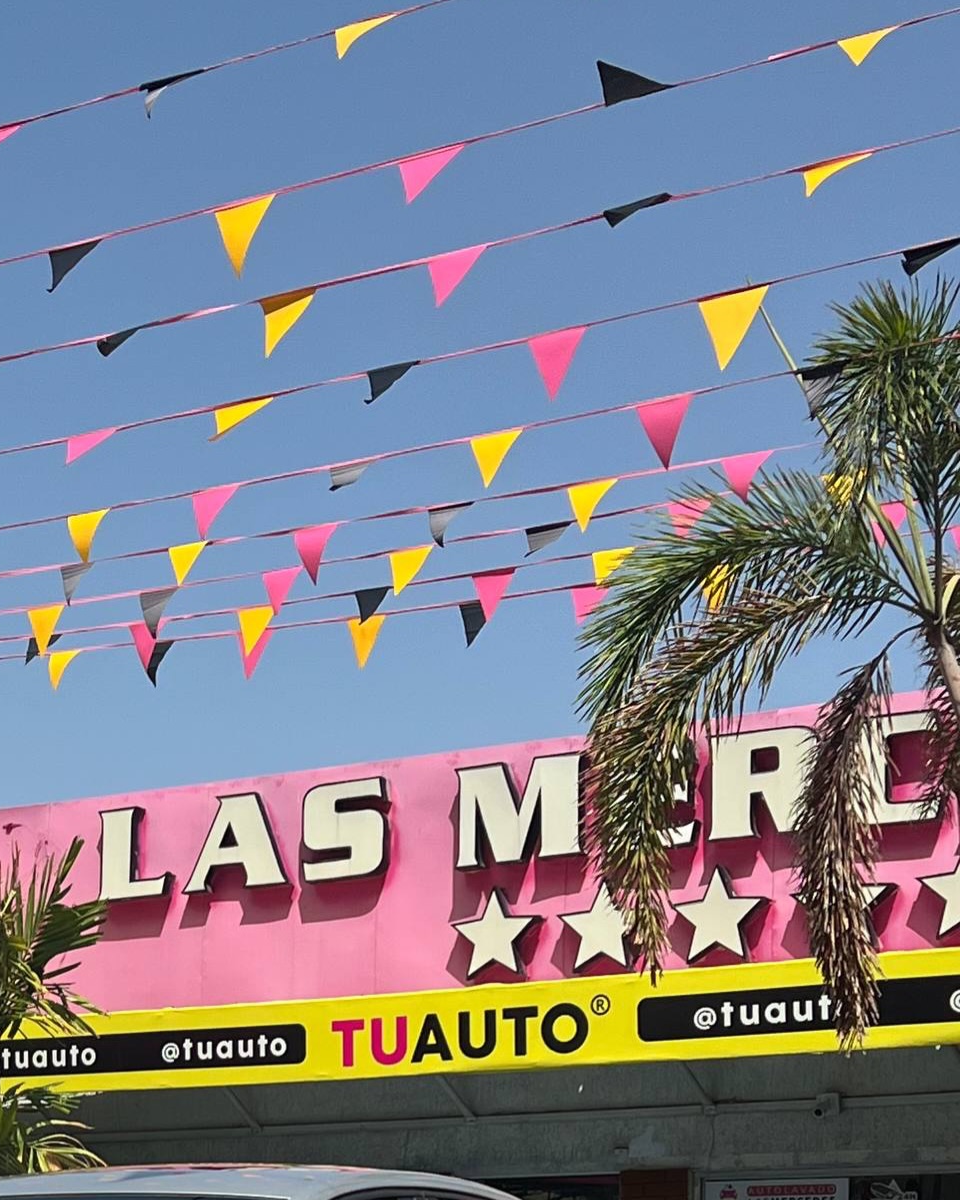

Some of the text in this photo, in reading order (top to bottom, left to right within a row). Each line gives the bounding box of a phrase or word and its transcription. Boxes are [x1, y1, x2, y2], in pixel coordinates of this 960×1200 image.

[98, 776, 388, 902] LAS
[693, 994, 841, 1030] @tuaut
[161, 1034, 288, 1063] @tuauto
